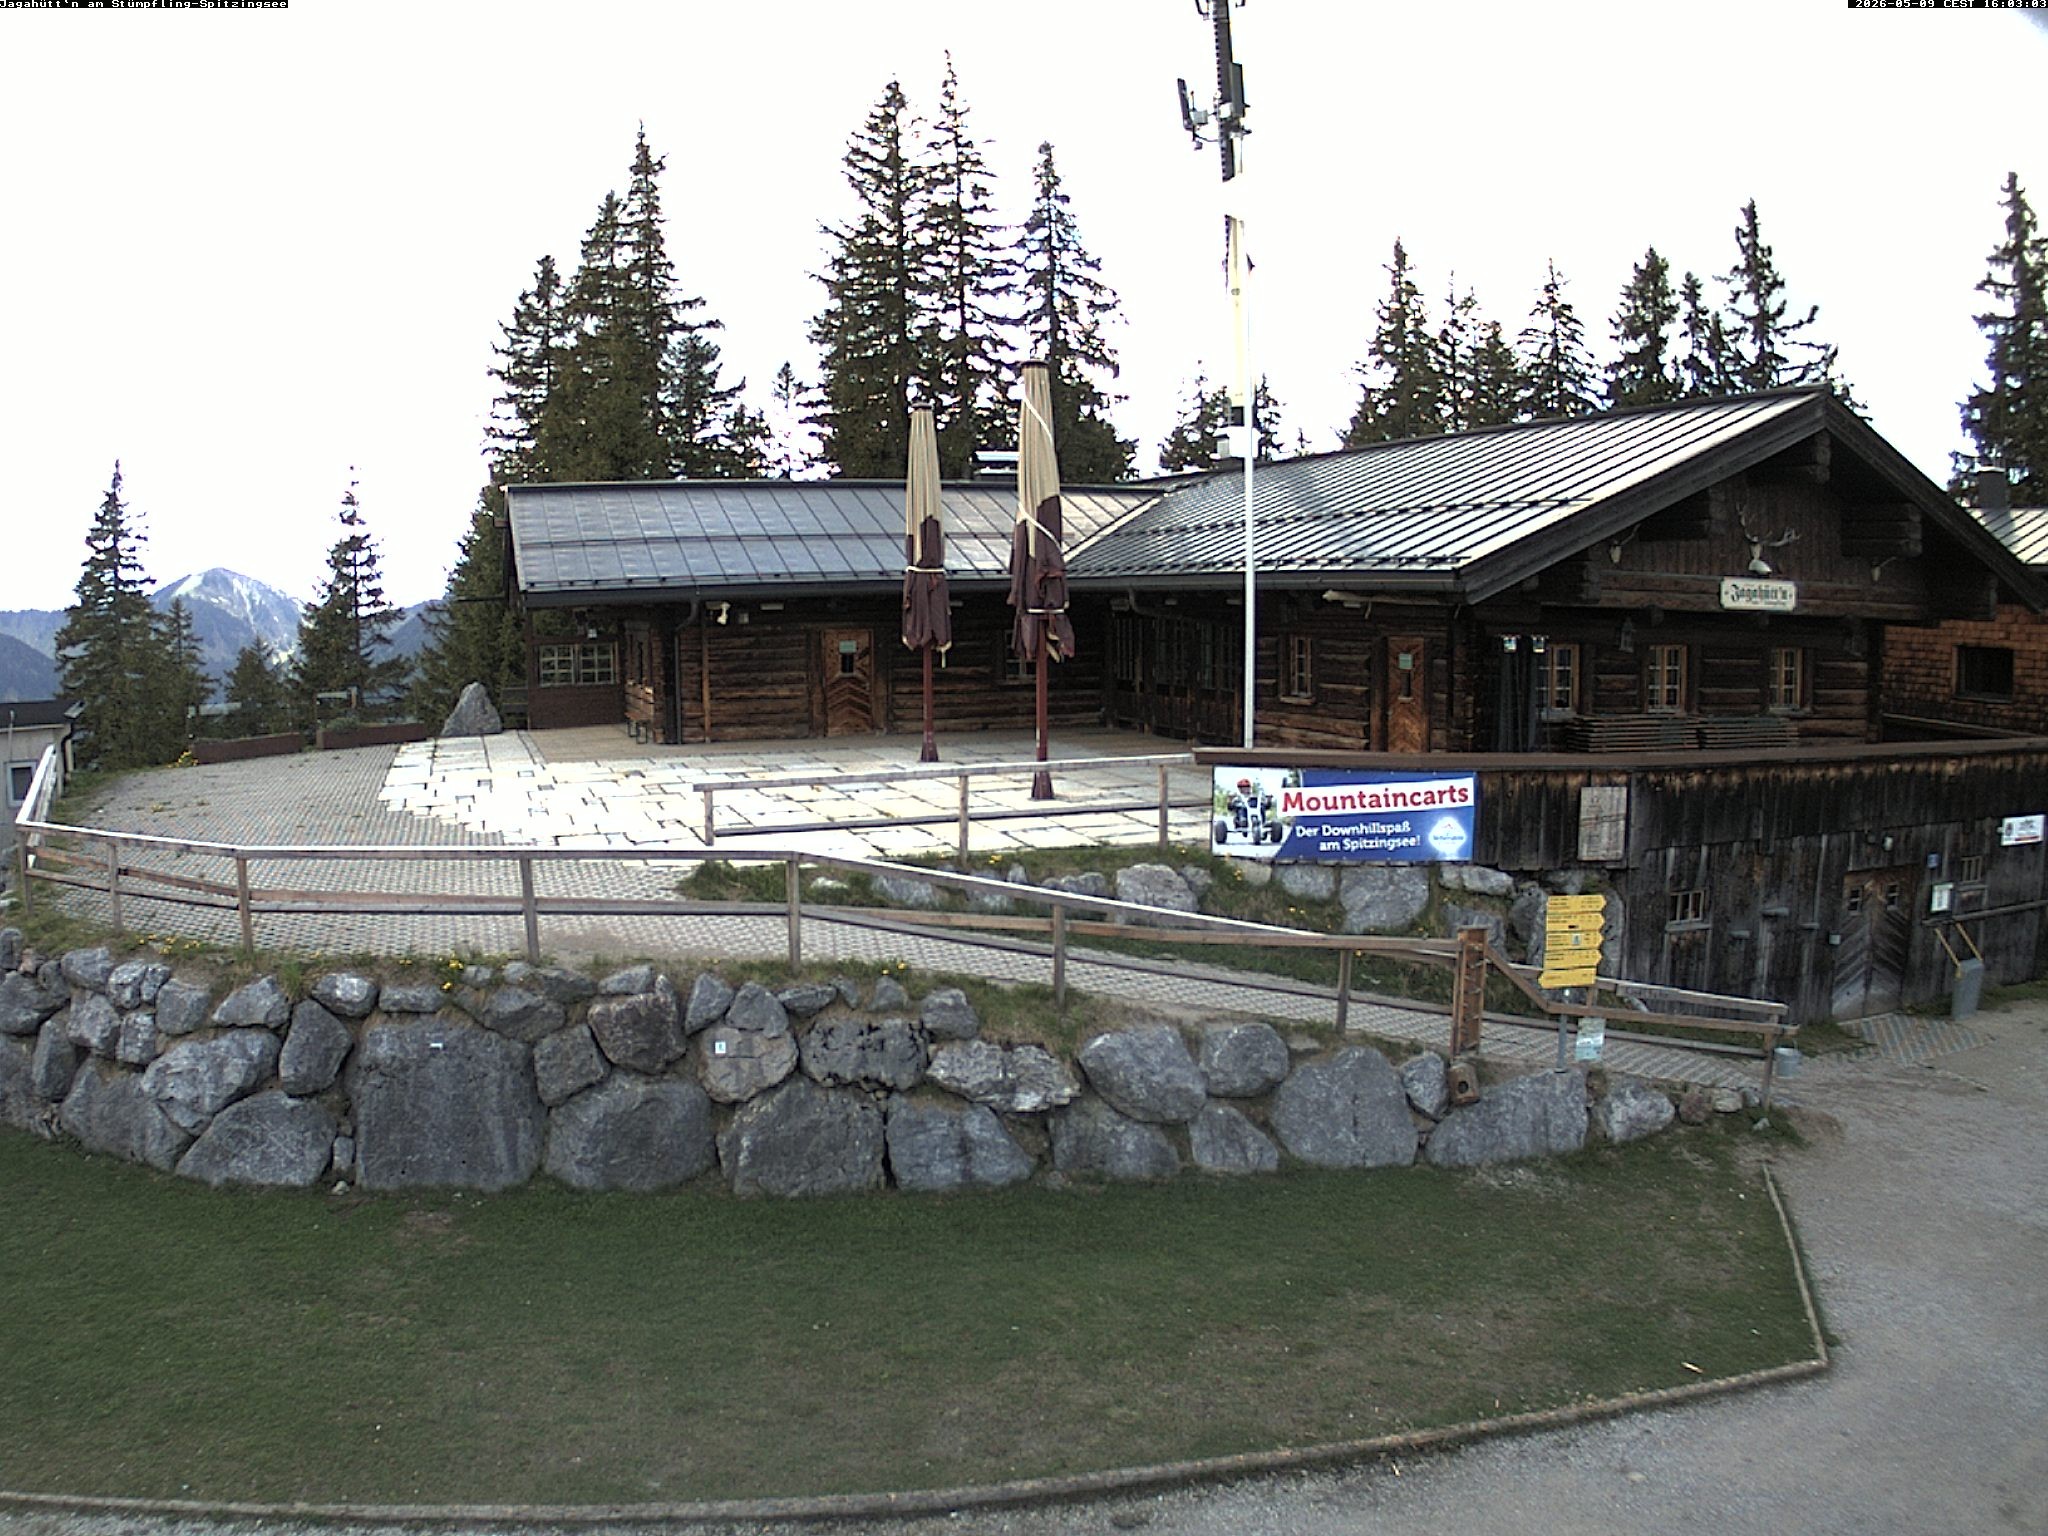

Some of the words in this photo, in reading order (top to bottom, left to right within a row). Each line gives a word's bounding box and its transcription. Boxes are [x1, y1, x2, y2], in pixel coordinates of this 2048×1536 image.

[1282, 785, 1469, 813] Mountaincarts
[1296, 825, 1319, 838] Der
[1321, 821, 1411, 837] Downhillspaß
[1319, 842, 1341, 852] am
[1342, 835, 1421, 851] Spitzingsee!
